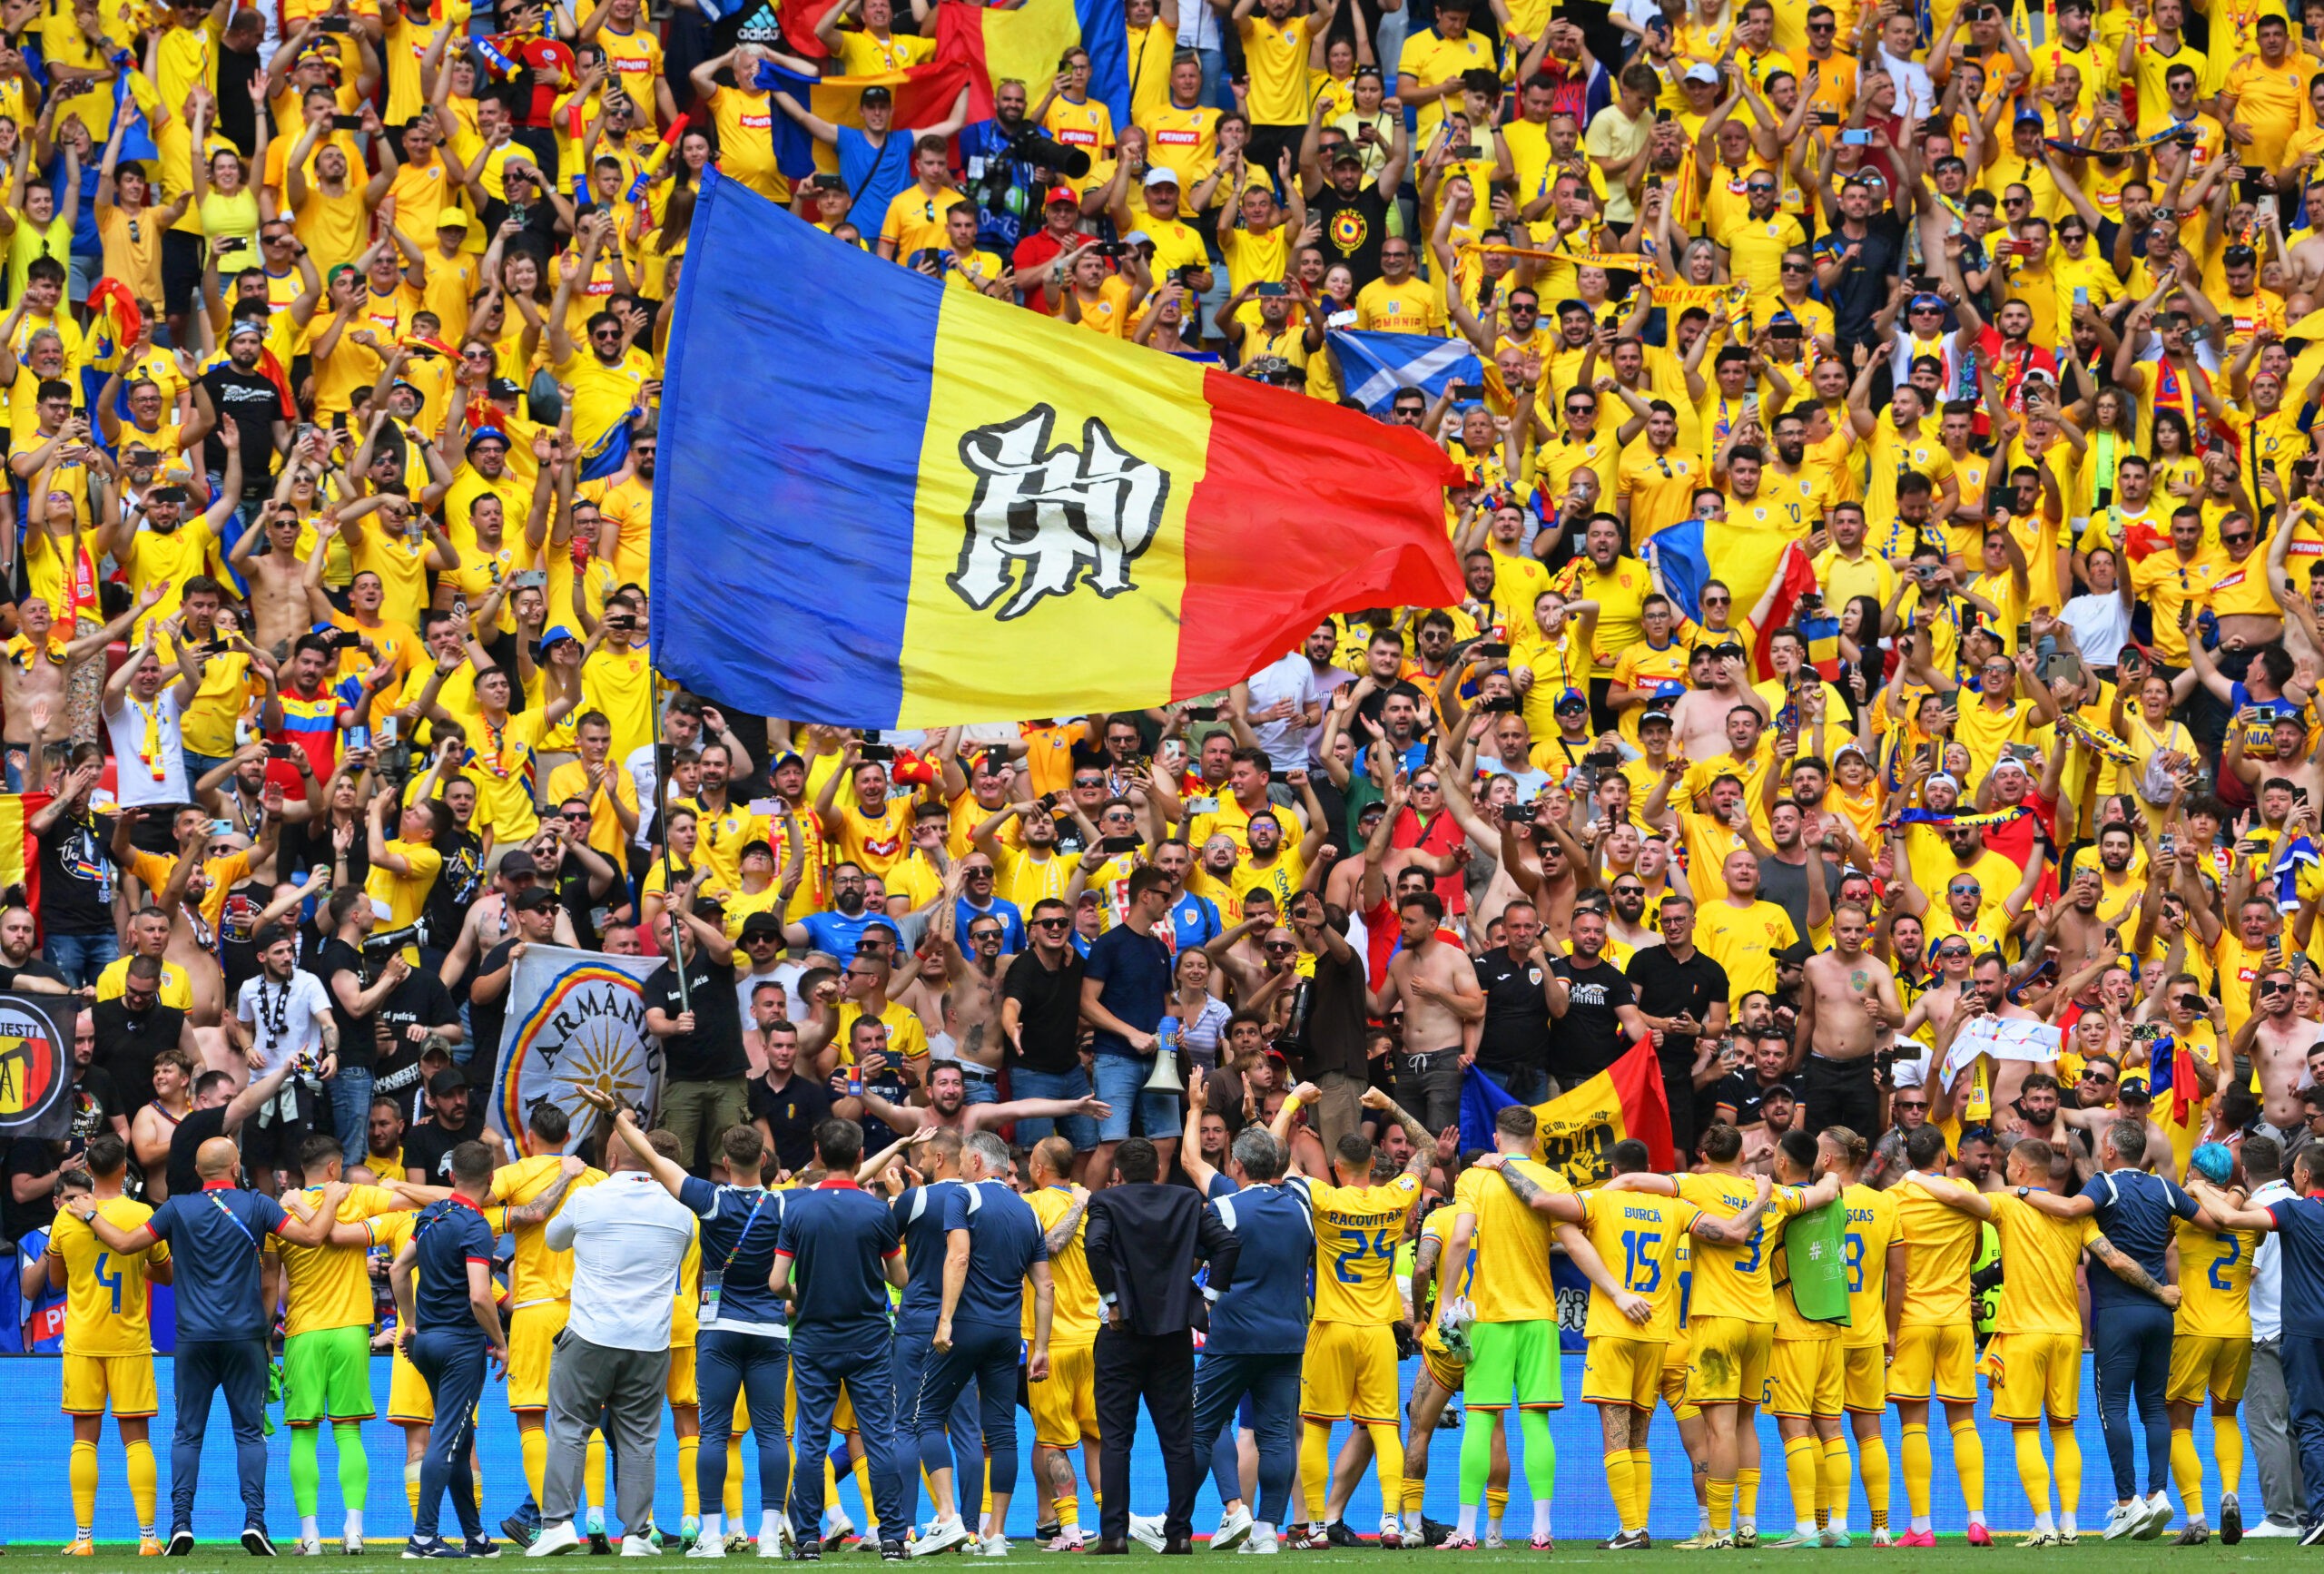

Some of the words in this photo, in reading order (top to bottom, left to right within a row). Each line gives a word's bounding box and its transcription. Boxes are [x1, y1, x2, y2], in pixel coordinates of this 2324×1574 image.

[1624, 1206, 1662, 1223] BURCĂ
[1846, 1208, 1875, 1225] ȘCAȘ
[94, 1252, 123, 1314] 4
[1334, 1229, 1396, 1283] 24
[1620, 1230, 1661, 1293] 15
[2208, 1233, 2241, 1291] 2
